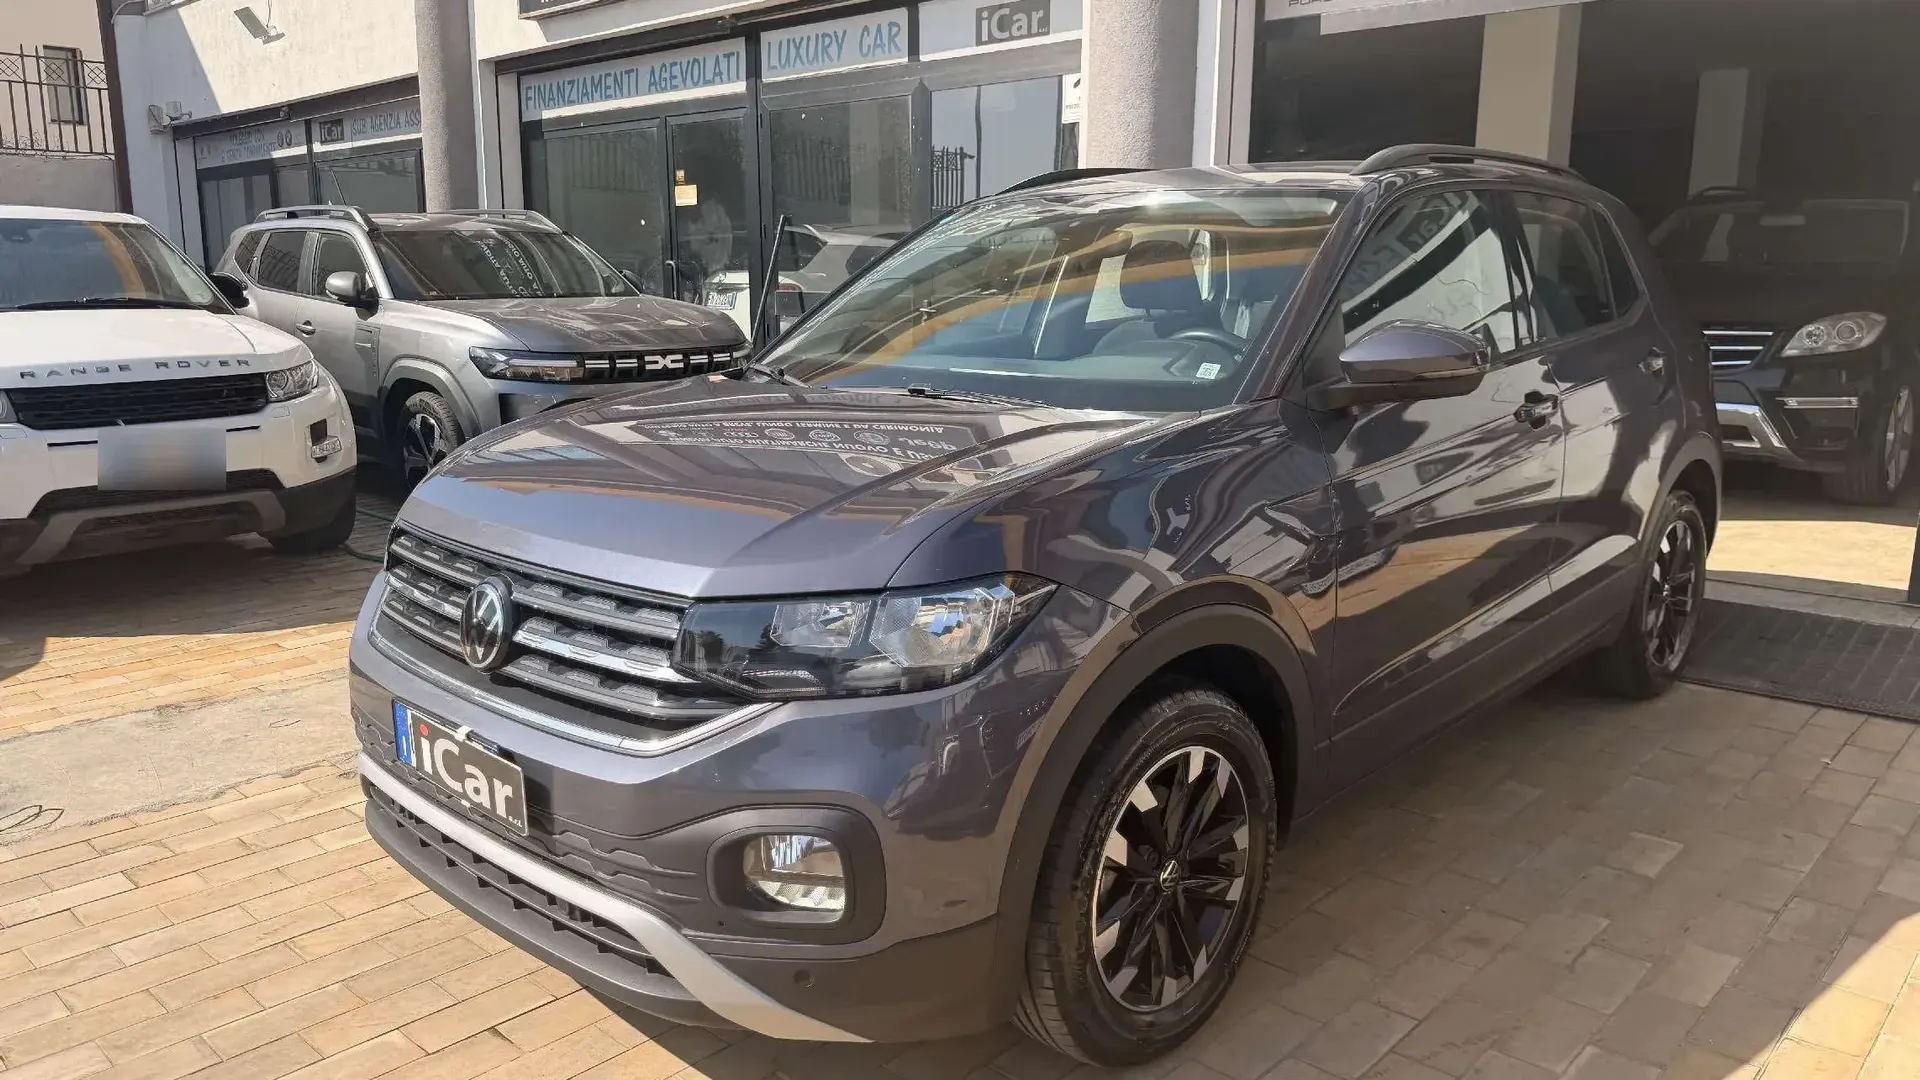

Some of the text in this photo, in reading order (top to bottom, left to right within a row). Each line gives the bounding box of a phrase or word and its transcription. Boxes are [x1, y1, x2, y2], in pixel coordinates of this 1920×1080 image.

[981, 7, 1044, 42] iCar
[767, 21, 902, 72] LUXURY CAR
[525, 51, 740, 110] FINANZIAMENTI AGEVOLATI
[321, 123, 342, 141] iCar
[352, 118, 368, 135] SUB
[370, 111, 401, 133] AGENZIA
[19, 358, 252, 380] RANGE ROVER
[419, 723, 513, 819] iCar
